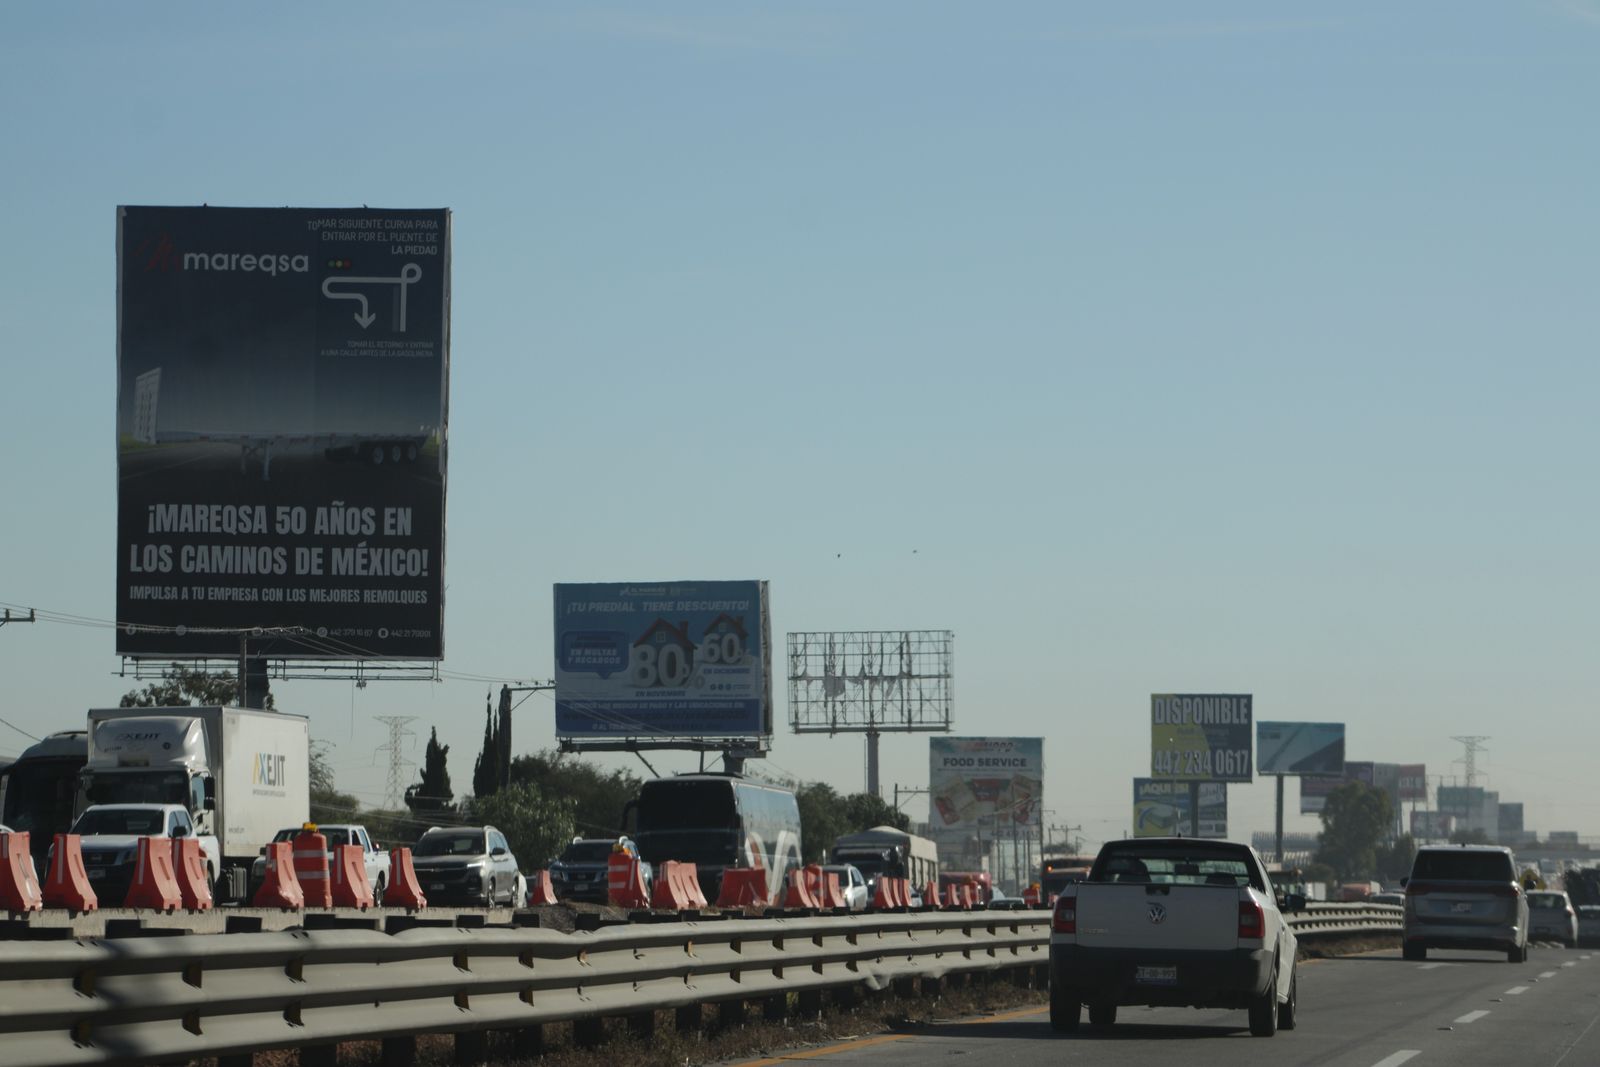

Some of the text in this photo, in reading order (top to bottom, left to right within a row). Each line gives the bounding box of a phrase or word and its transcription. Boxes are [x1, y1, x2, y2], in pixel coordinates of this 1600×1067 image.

[307, 218, 438, 231] TOMAR SIGUIENTE CURVA PARA
[322, 231, 438, 243] ENTRAR POR EL PUENTE DE
[391, 245, 438, 255] LA PIEDAD
[183, 252, 309, 276] mareqsa
[147, 500, 412, 536] ¡MAREQSA 50 AÑOS EN
[130, 541, 429, 577] LOS CAMINOS DE MÉXICO!
[129, 586, 428, 604] IMPULSA A TU EMPRESA CON LOS MEJORES REMOLQUES
[588, 602, 635, 612] PREDIAL
[642, 601, 674, 611] TIENE
[676, 600, 749, 611] DESCUENTO!
[584, 648, 617, 656] MULTAS
[575, 656, 621, 664] RECARGOS
[1154, 697, 1248, 725] DISPONIBLE
[252, 752, 285, 786] AXEJIT
[943, 757, 1027, 767] FOOD SERVICE
[1154, 749, 1249, 775] 442 234 0617
